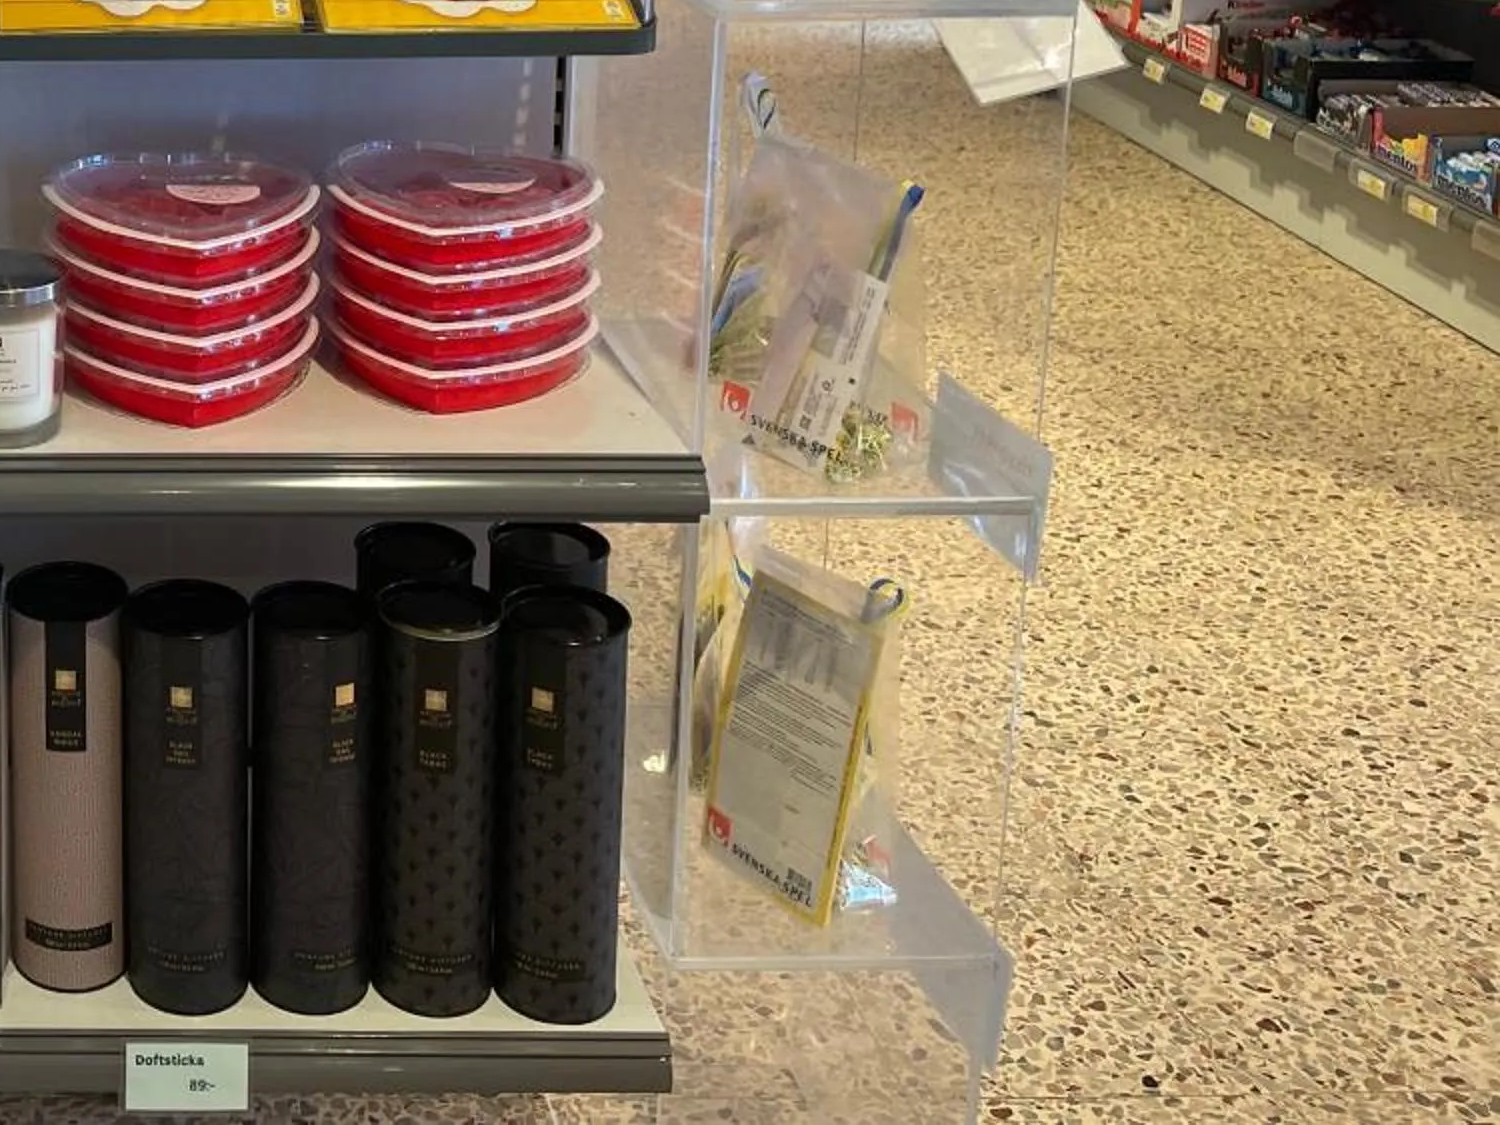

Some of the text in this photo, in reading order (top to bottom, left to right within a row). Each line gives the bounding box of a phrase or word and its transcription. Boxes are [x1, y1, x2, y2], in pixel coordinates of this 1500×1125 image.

[750, 414, 807, 451] SVENSKA
[731, 842, 781, 883] SVENSKA
[135, 1054, 205, 1066] Doftsticka
[188, 1078, 216, 1092] 89:-
